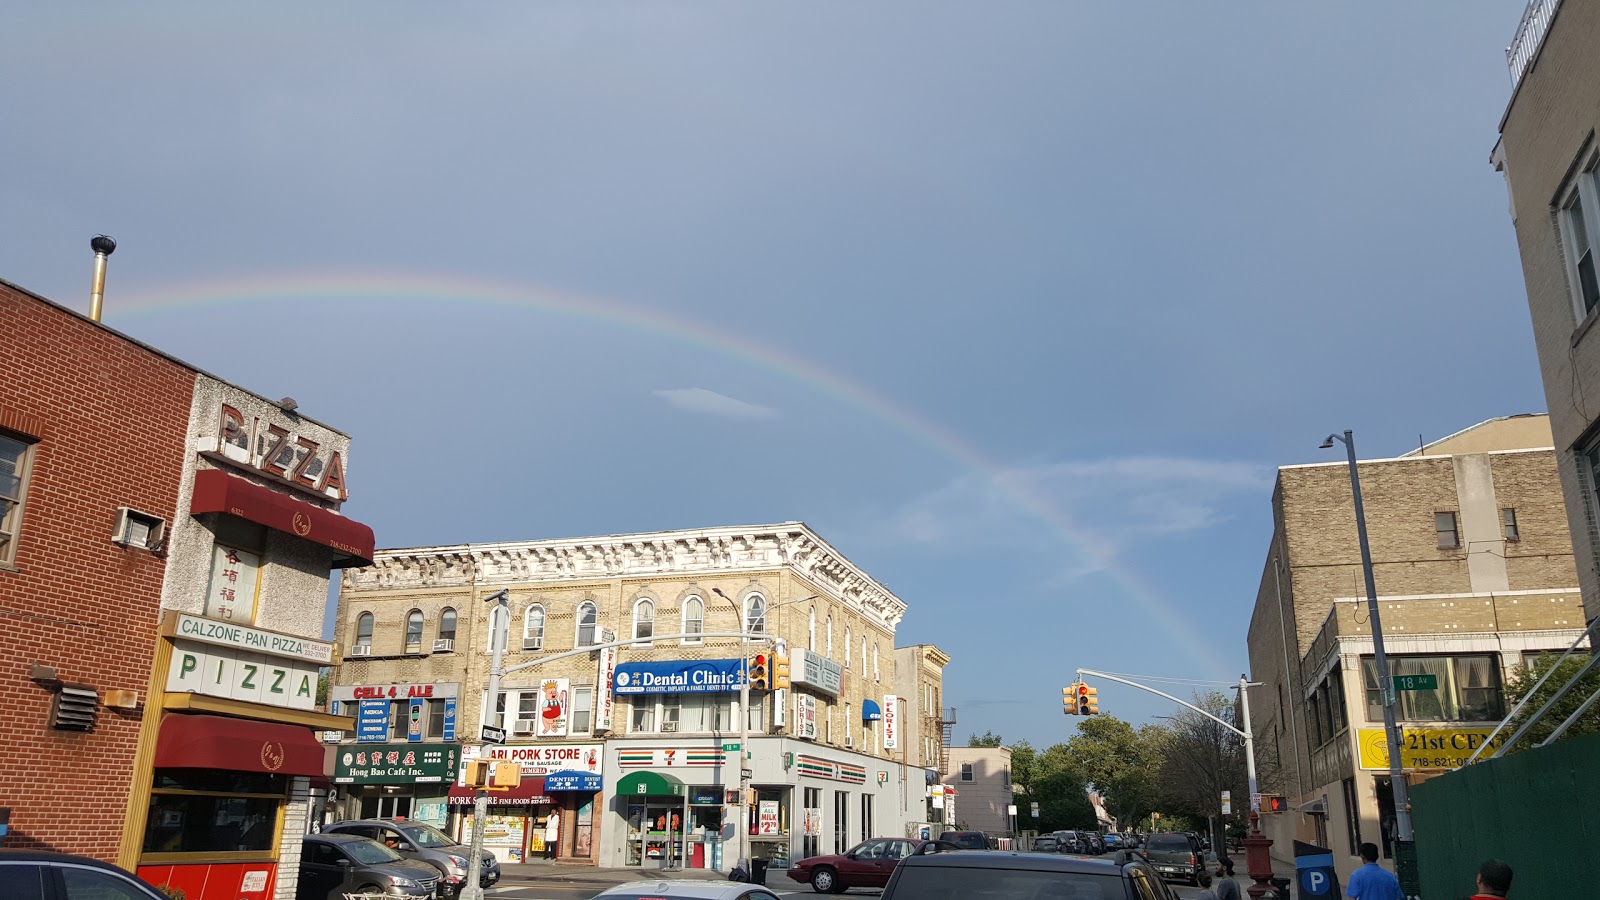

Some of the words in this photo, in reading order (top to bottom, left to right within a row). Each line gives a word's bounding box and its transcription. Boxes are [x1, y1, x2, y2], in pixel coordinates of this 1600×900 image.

[217, 403, 348, 501] PIZZA
[231, 507, 244, 517] 6322
[330, 540, 362, 556] 718-232-2700
[182, 619, 241, 643] CALZONE
[245, 632, 268, 647] PAN
[272, 637, 303, 655] PIZZA
[305, 650, 327, 659] 232-2700
[179, 654, 311, 698] PIZZA
[643, 671, 688, 686] Dental
[692, 670, 734, 685] Clinic
[1401, 677, 1414, 689] 18
[1418, 677, 1428, 685] Av
[354, 687, 385, 699] CELL
[388, 686, 397, 698] 4
[604, 653, 613, 717] FLORIST
[885, 702, 894, 739] FLORIST
[485, 730, 493, 738] ONE
[1409, 734, 1445, 750] 21st
[512, 749, 542, 760] PORK
[545, 748, 580, 760] STORE
[664, 749, 676, 766] 7
[349, 768, 369, 778] Hong
[371, 768, 385, 776] Bao
[388, 768, 406, 776] Cafe
[408, 767, 425, 776] Inc.
[450, 796, 471, 805] PORK
[472, 796, 498, 805] SRE
[1310, 872, 1324, 892] P
